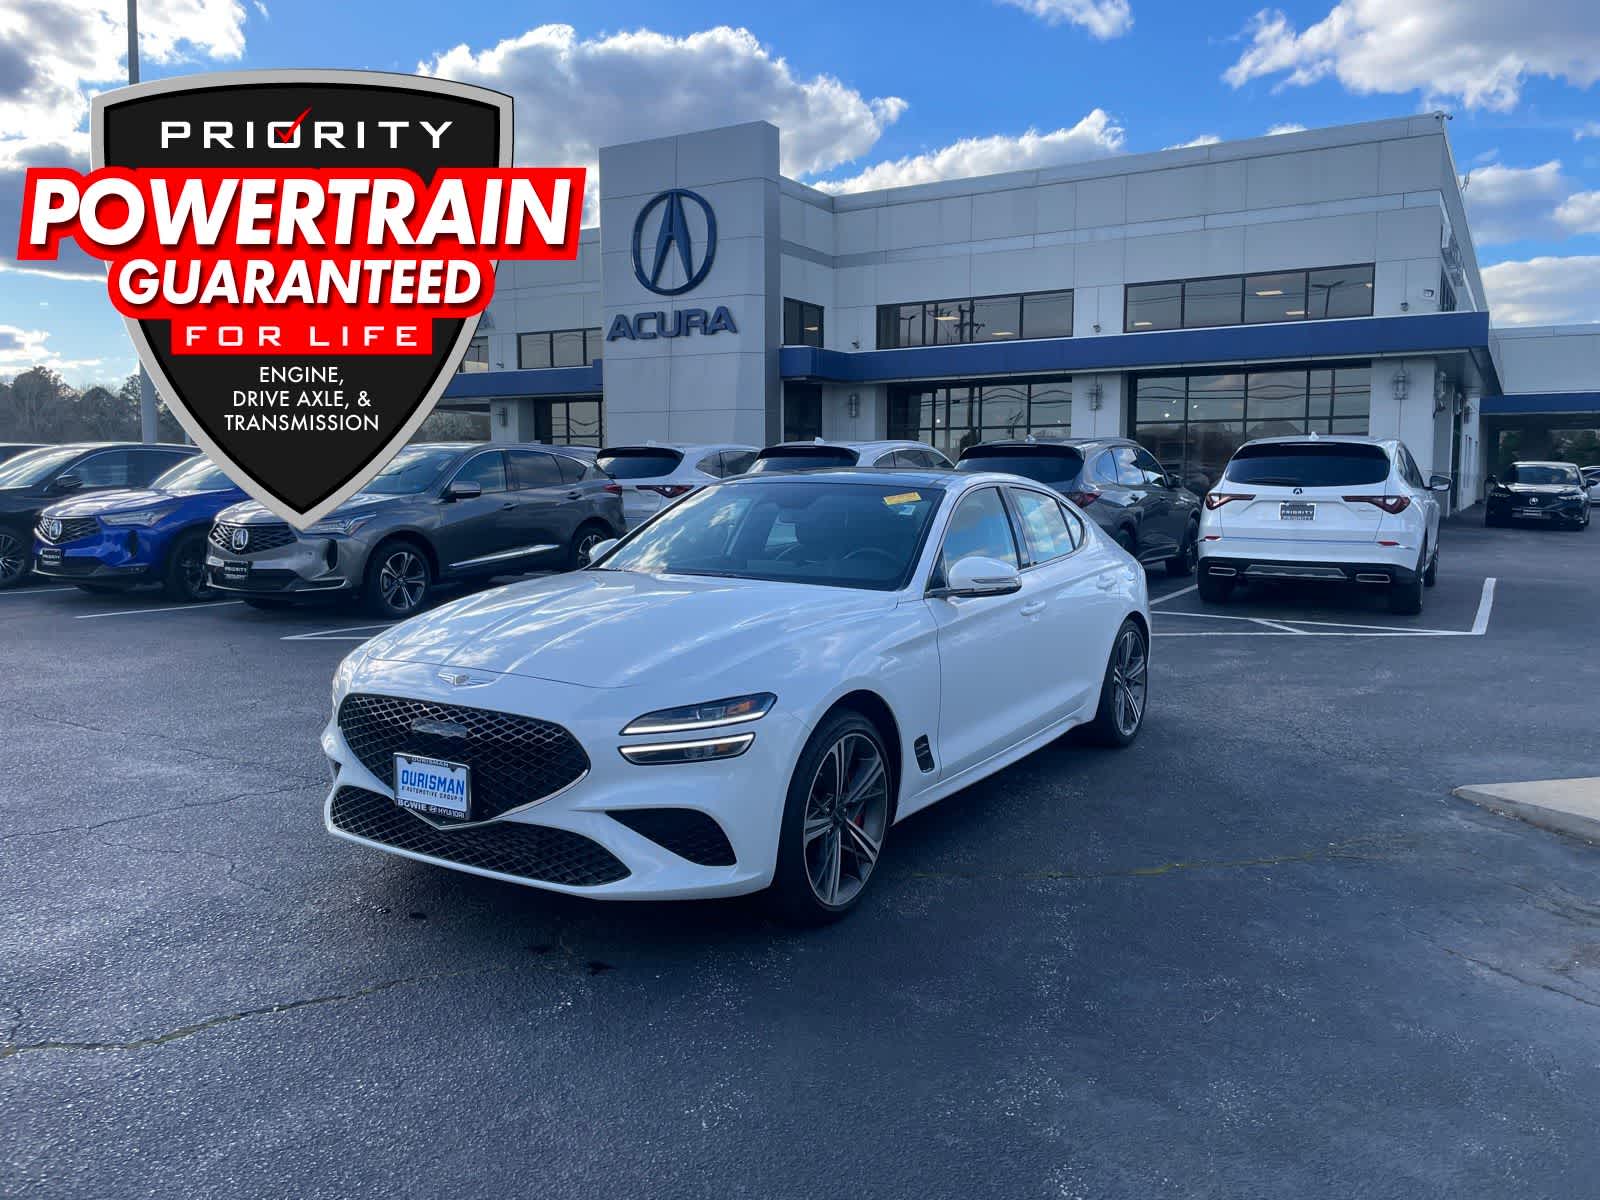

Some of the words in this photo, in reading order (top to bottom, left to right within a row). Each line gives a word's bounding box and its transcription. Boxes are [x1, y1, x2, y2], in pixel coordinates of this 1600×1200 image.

[606, 305, 738, 342] ACURA
[402, 769, 465, 795] OURISMAN
[406, 786, 437, 797] AUTOMOTIVE
[439, 793, 458, 801] GROUP
[398, 800, 427, 811] BOWIE
[438, 807, 465, 819] HYUNDAI
